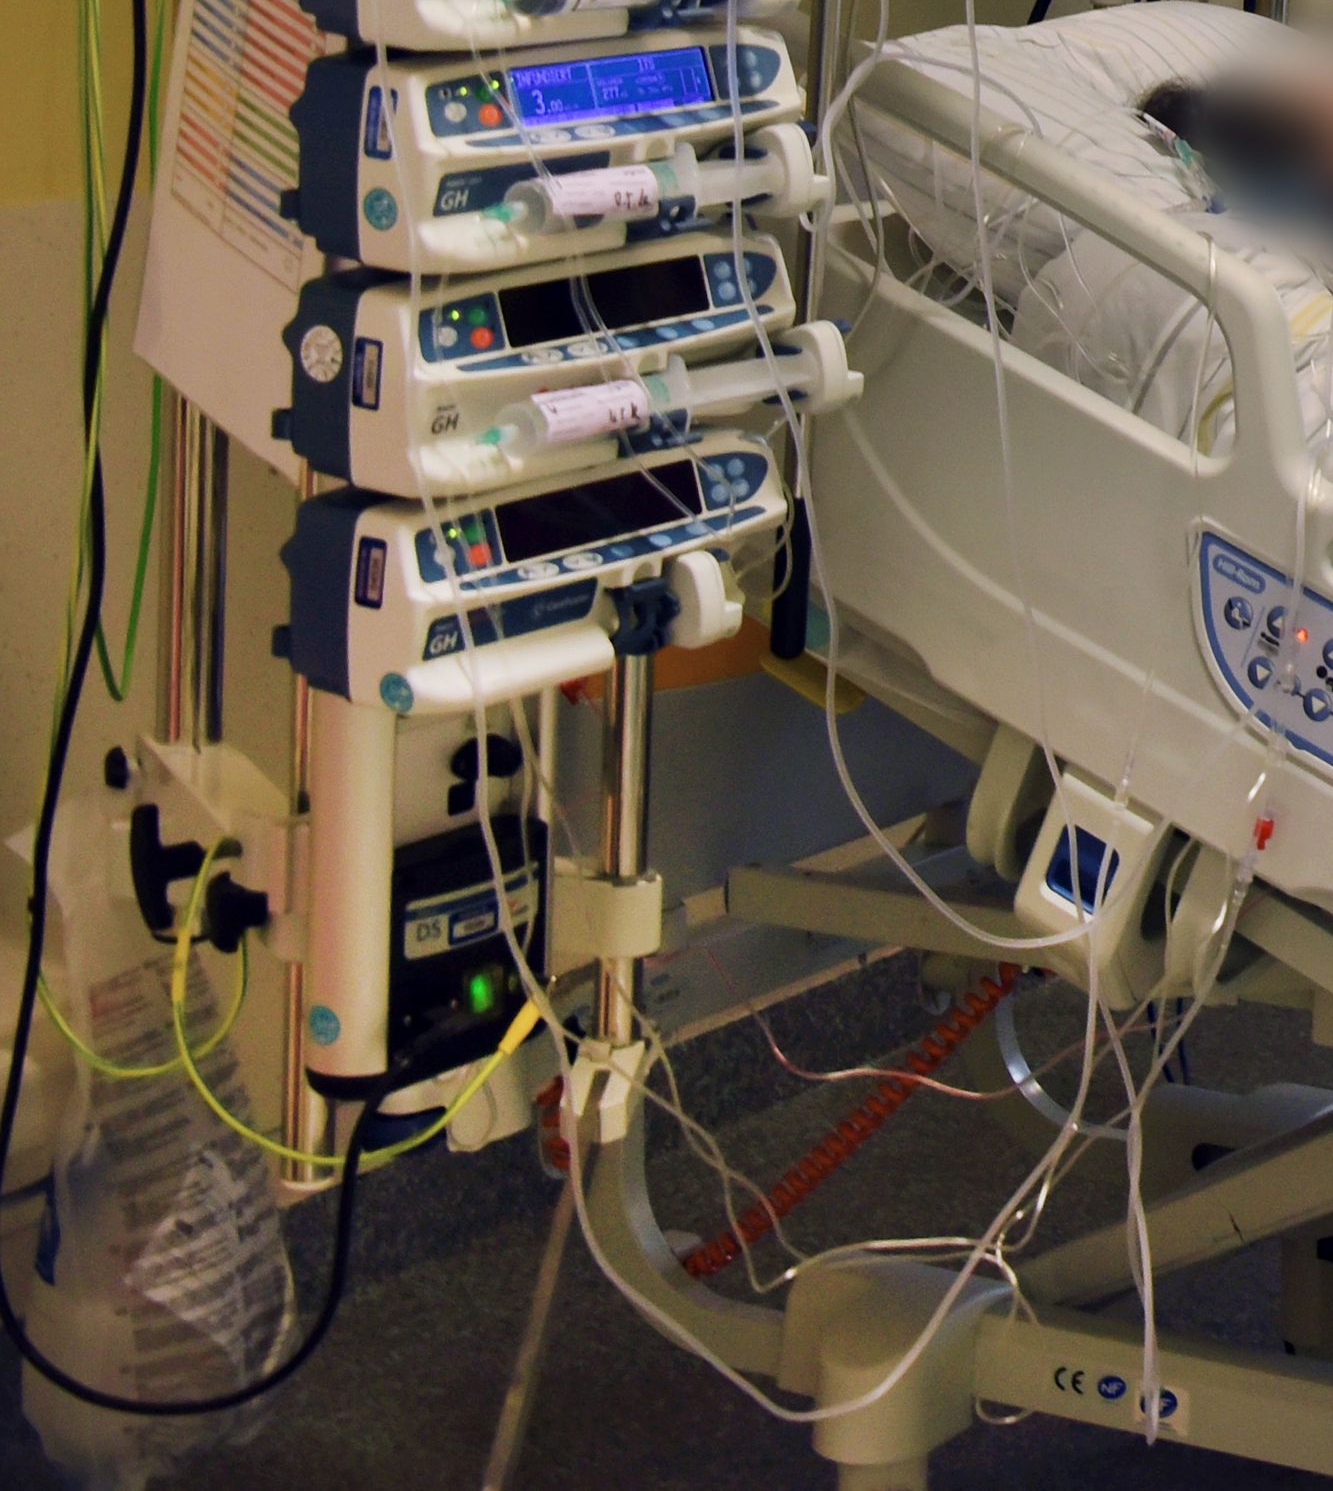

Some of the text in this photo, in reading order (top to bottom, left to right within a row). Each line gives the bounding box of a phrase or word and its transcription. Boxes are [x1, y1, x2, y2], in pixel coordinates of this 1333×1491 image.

[440, 189, 469, 210] GH
[431, 413, 460, 435] GH
[429, 629, 458, 653] GH
